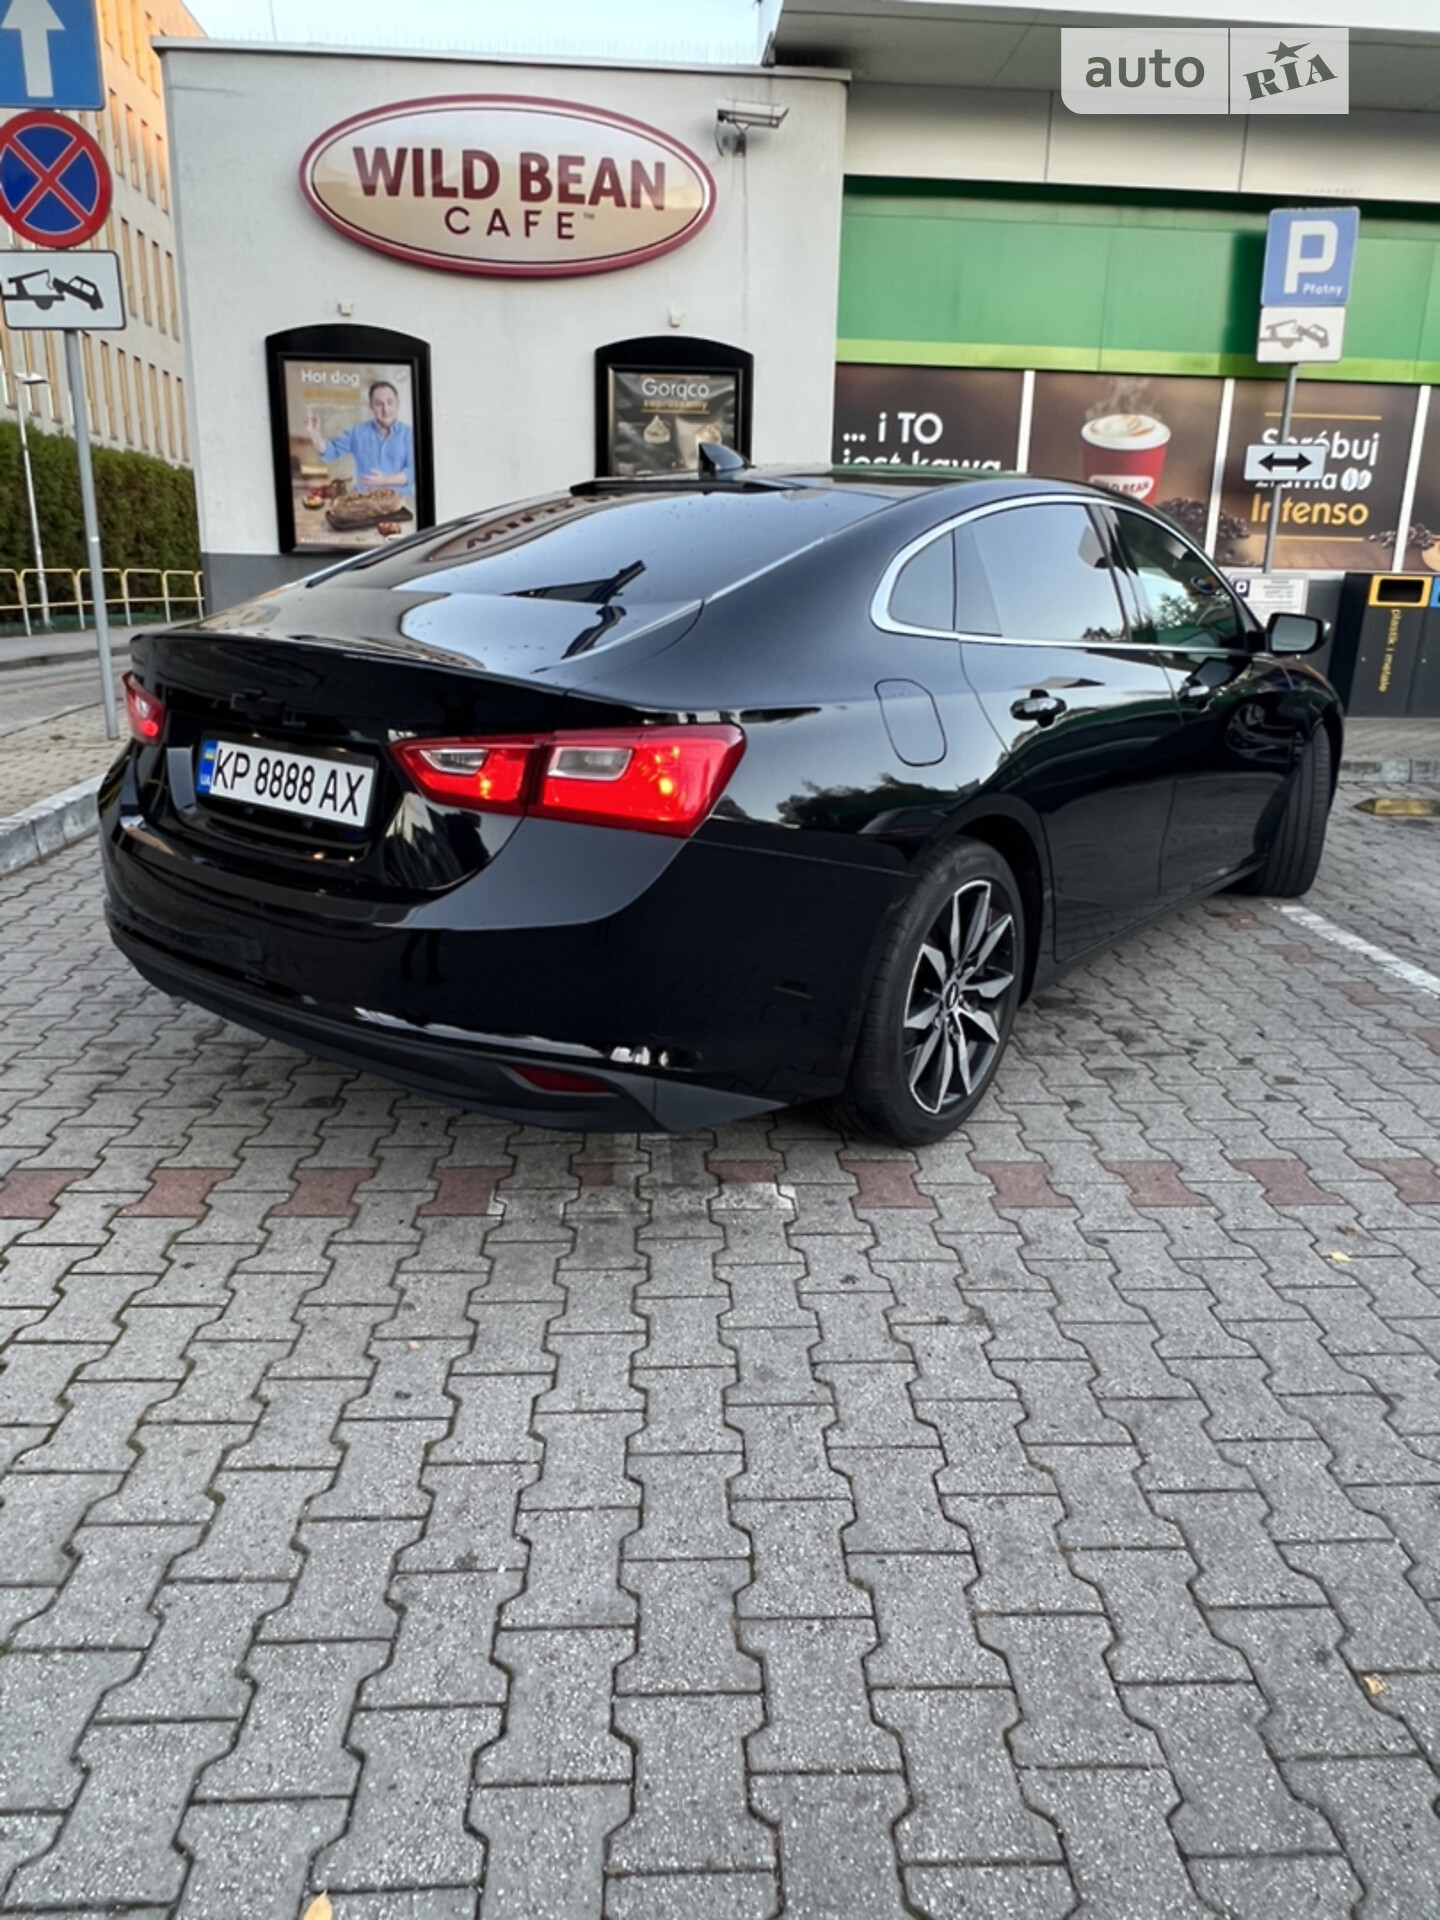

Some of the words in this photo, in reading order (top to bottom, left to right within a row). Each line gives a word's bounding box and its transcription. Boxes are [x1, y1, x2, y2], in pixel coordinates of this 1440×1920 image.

[352, 146, 499, 199] WILD
[519, 152, 665, 211] BEAN
[444, 206, 575, 240] CAFE
[1283, 220, 1338, 294] P
[301, 369, 327, 384] Hot
[331, 370, 361, 387] dog
[877, 412, 887, 443] i
[897, 412, 943, 444] TO
[213, 748, 251, 790] KP
[254, 756, 316, 805] 8888
[318, 768, 365, 817] AX
